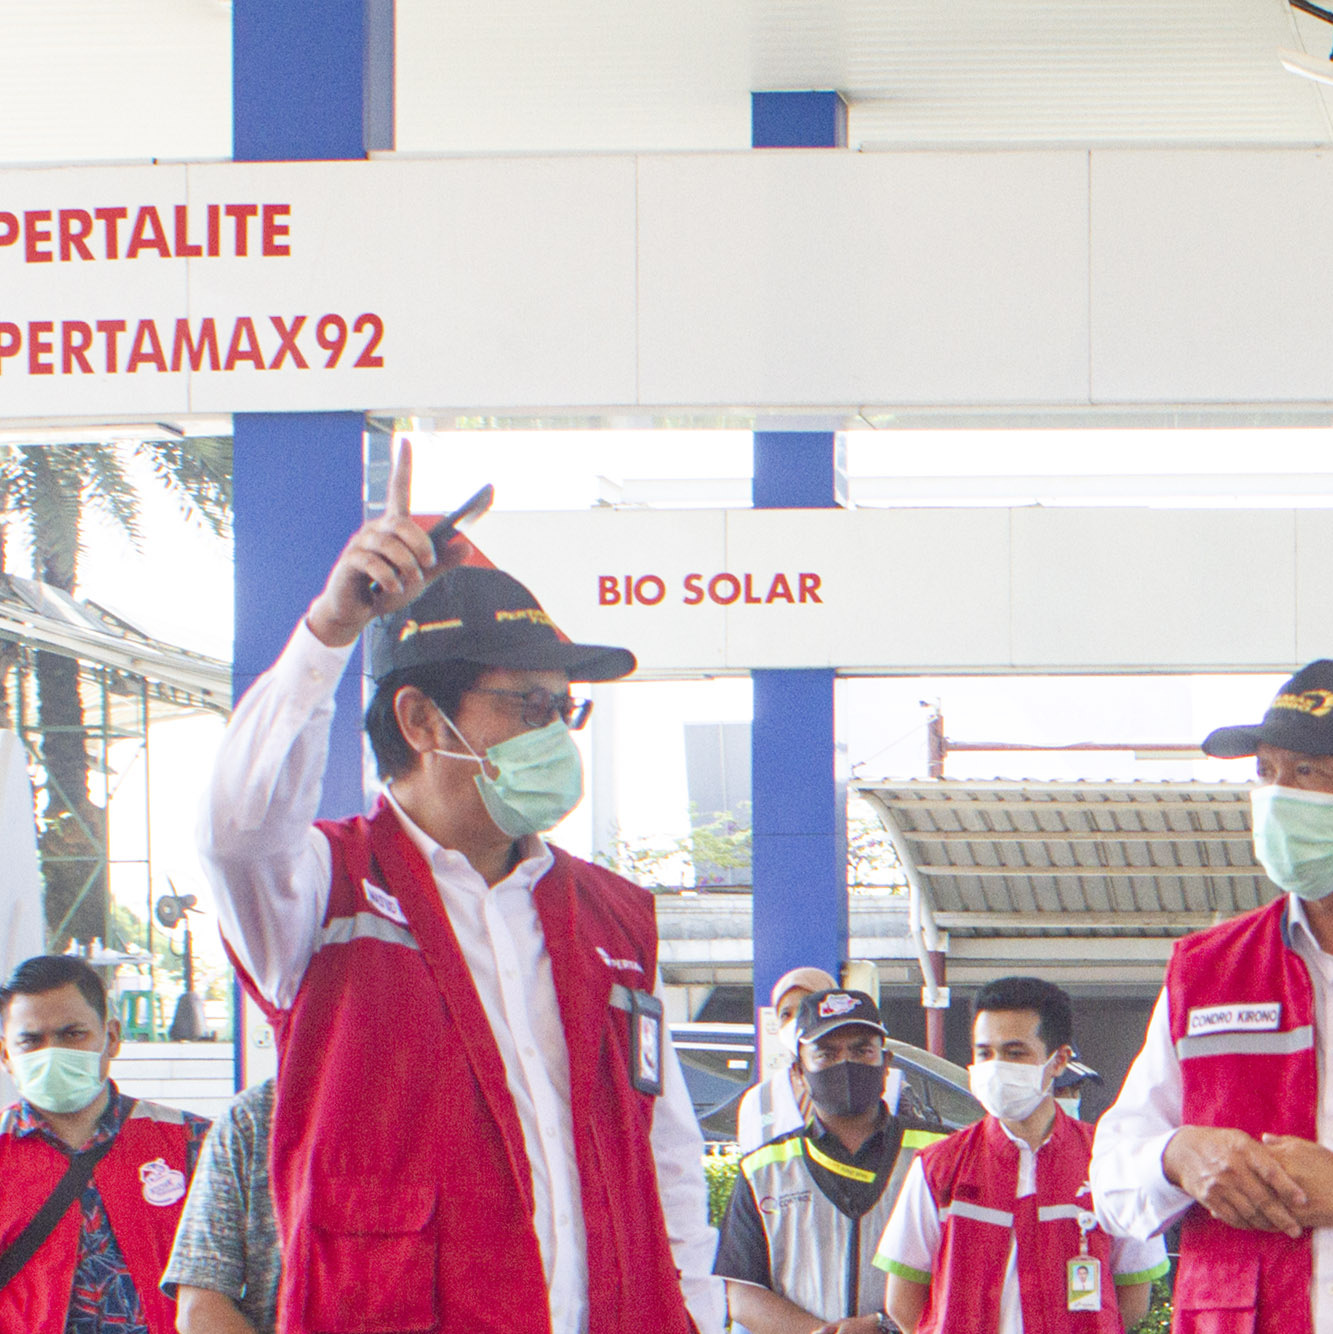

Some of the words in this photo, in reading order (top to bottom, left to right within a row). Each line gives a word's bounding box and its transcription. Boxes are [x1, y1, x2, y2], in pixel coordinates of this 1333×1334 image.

[0, 204, 291, 263] PERTALITE
[0, 312, 385, 375] PERTAMAX92
[598, 574, 666, 606] BIO
[682, 572, 824, 606] SOLAR
[1192, 1011, 1233, 1028] CONDRO
[1238, 1010, 1278, 1023] KIRONO
